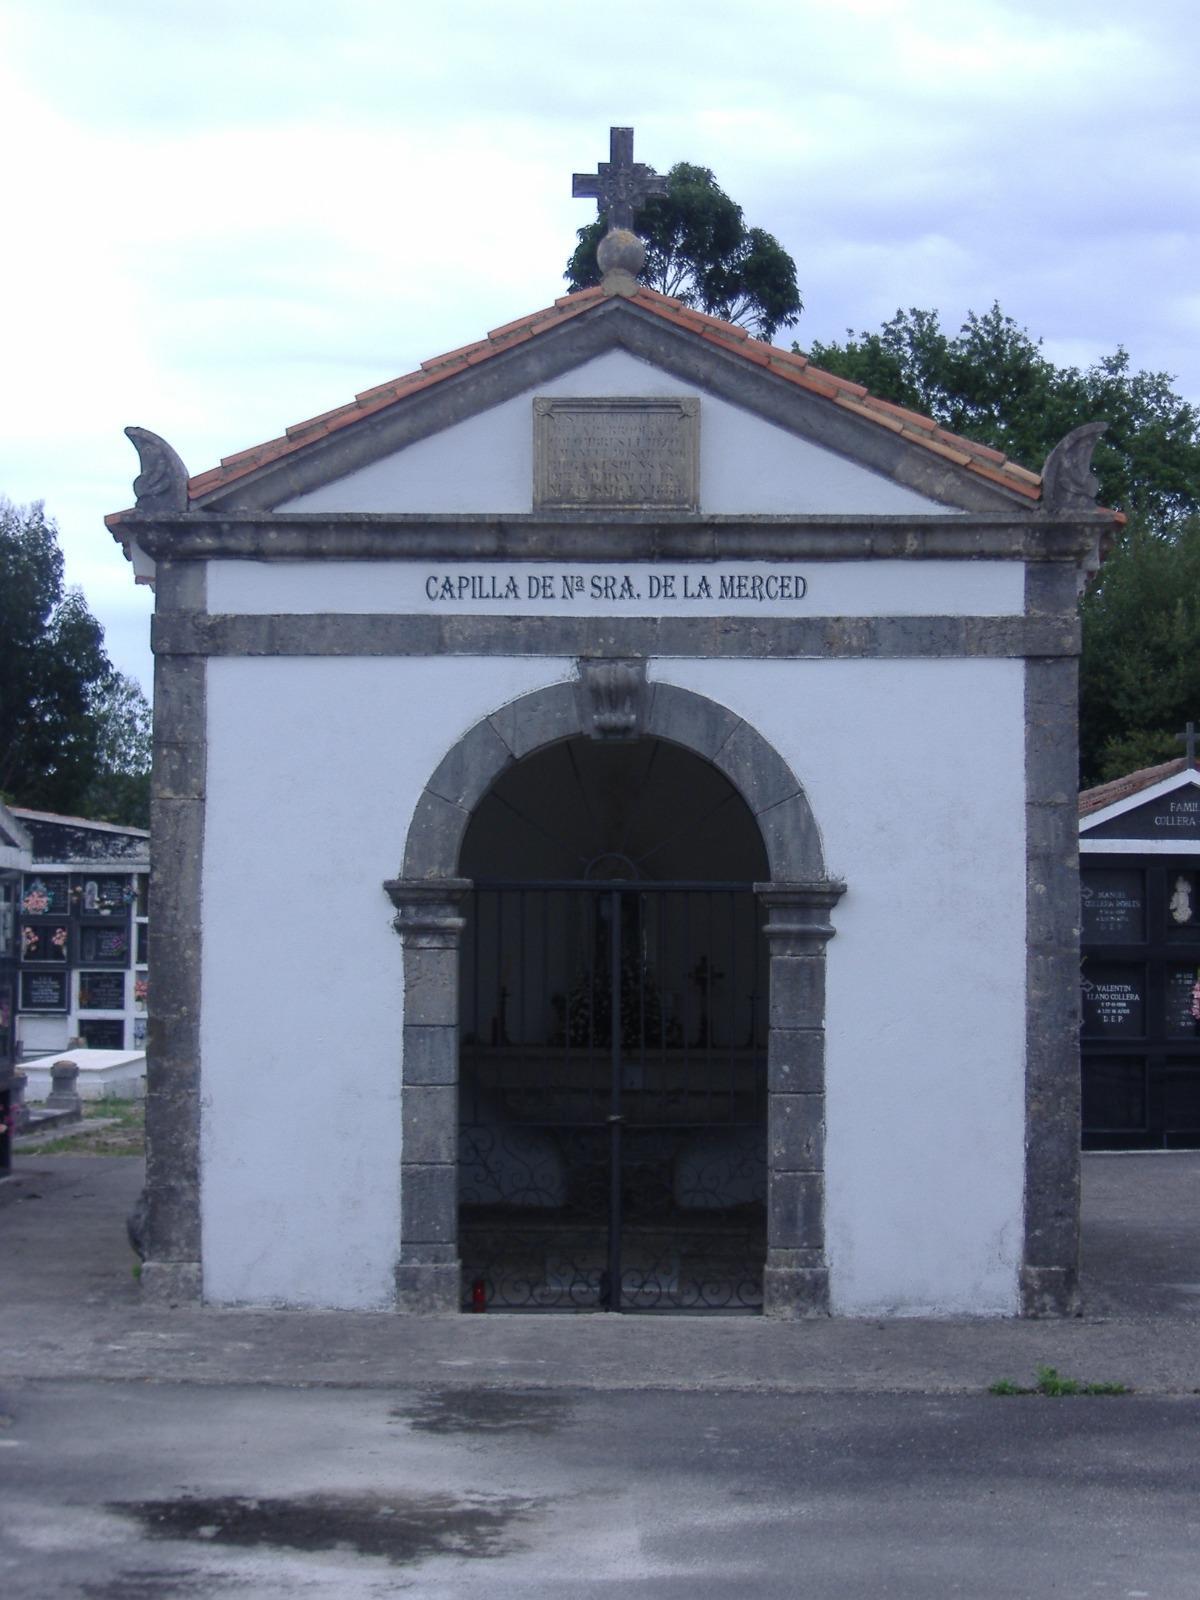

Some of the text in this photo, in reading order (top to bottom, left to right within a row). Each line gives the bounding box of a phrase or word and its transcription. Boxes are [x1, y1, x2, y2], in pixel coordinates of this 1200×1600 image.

[425, 575, 808, 602] CAPILLA DE Nª SRA. DE LA MERCED
[1154, 816, 1196, 826] COLLERA
[1110, 993, 1141, 1001] COLLERA
